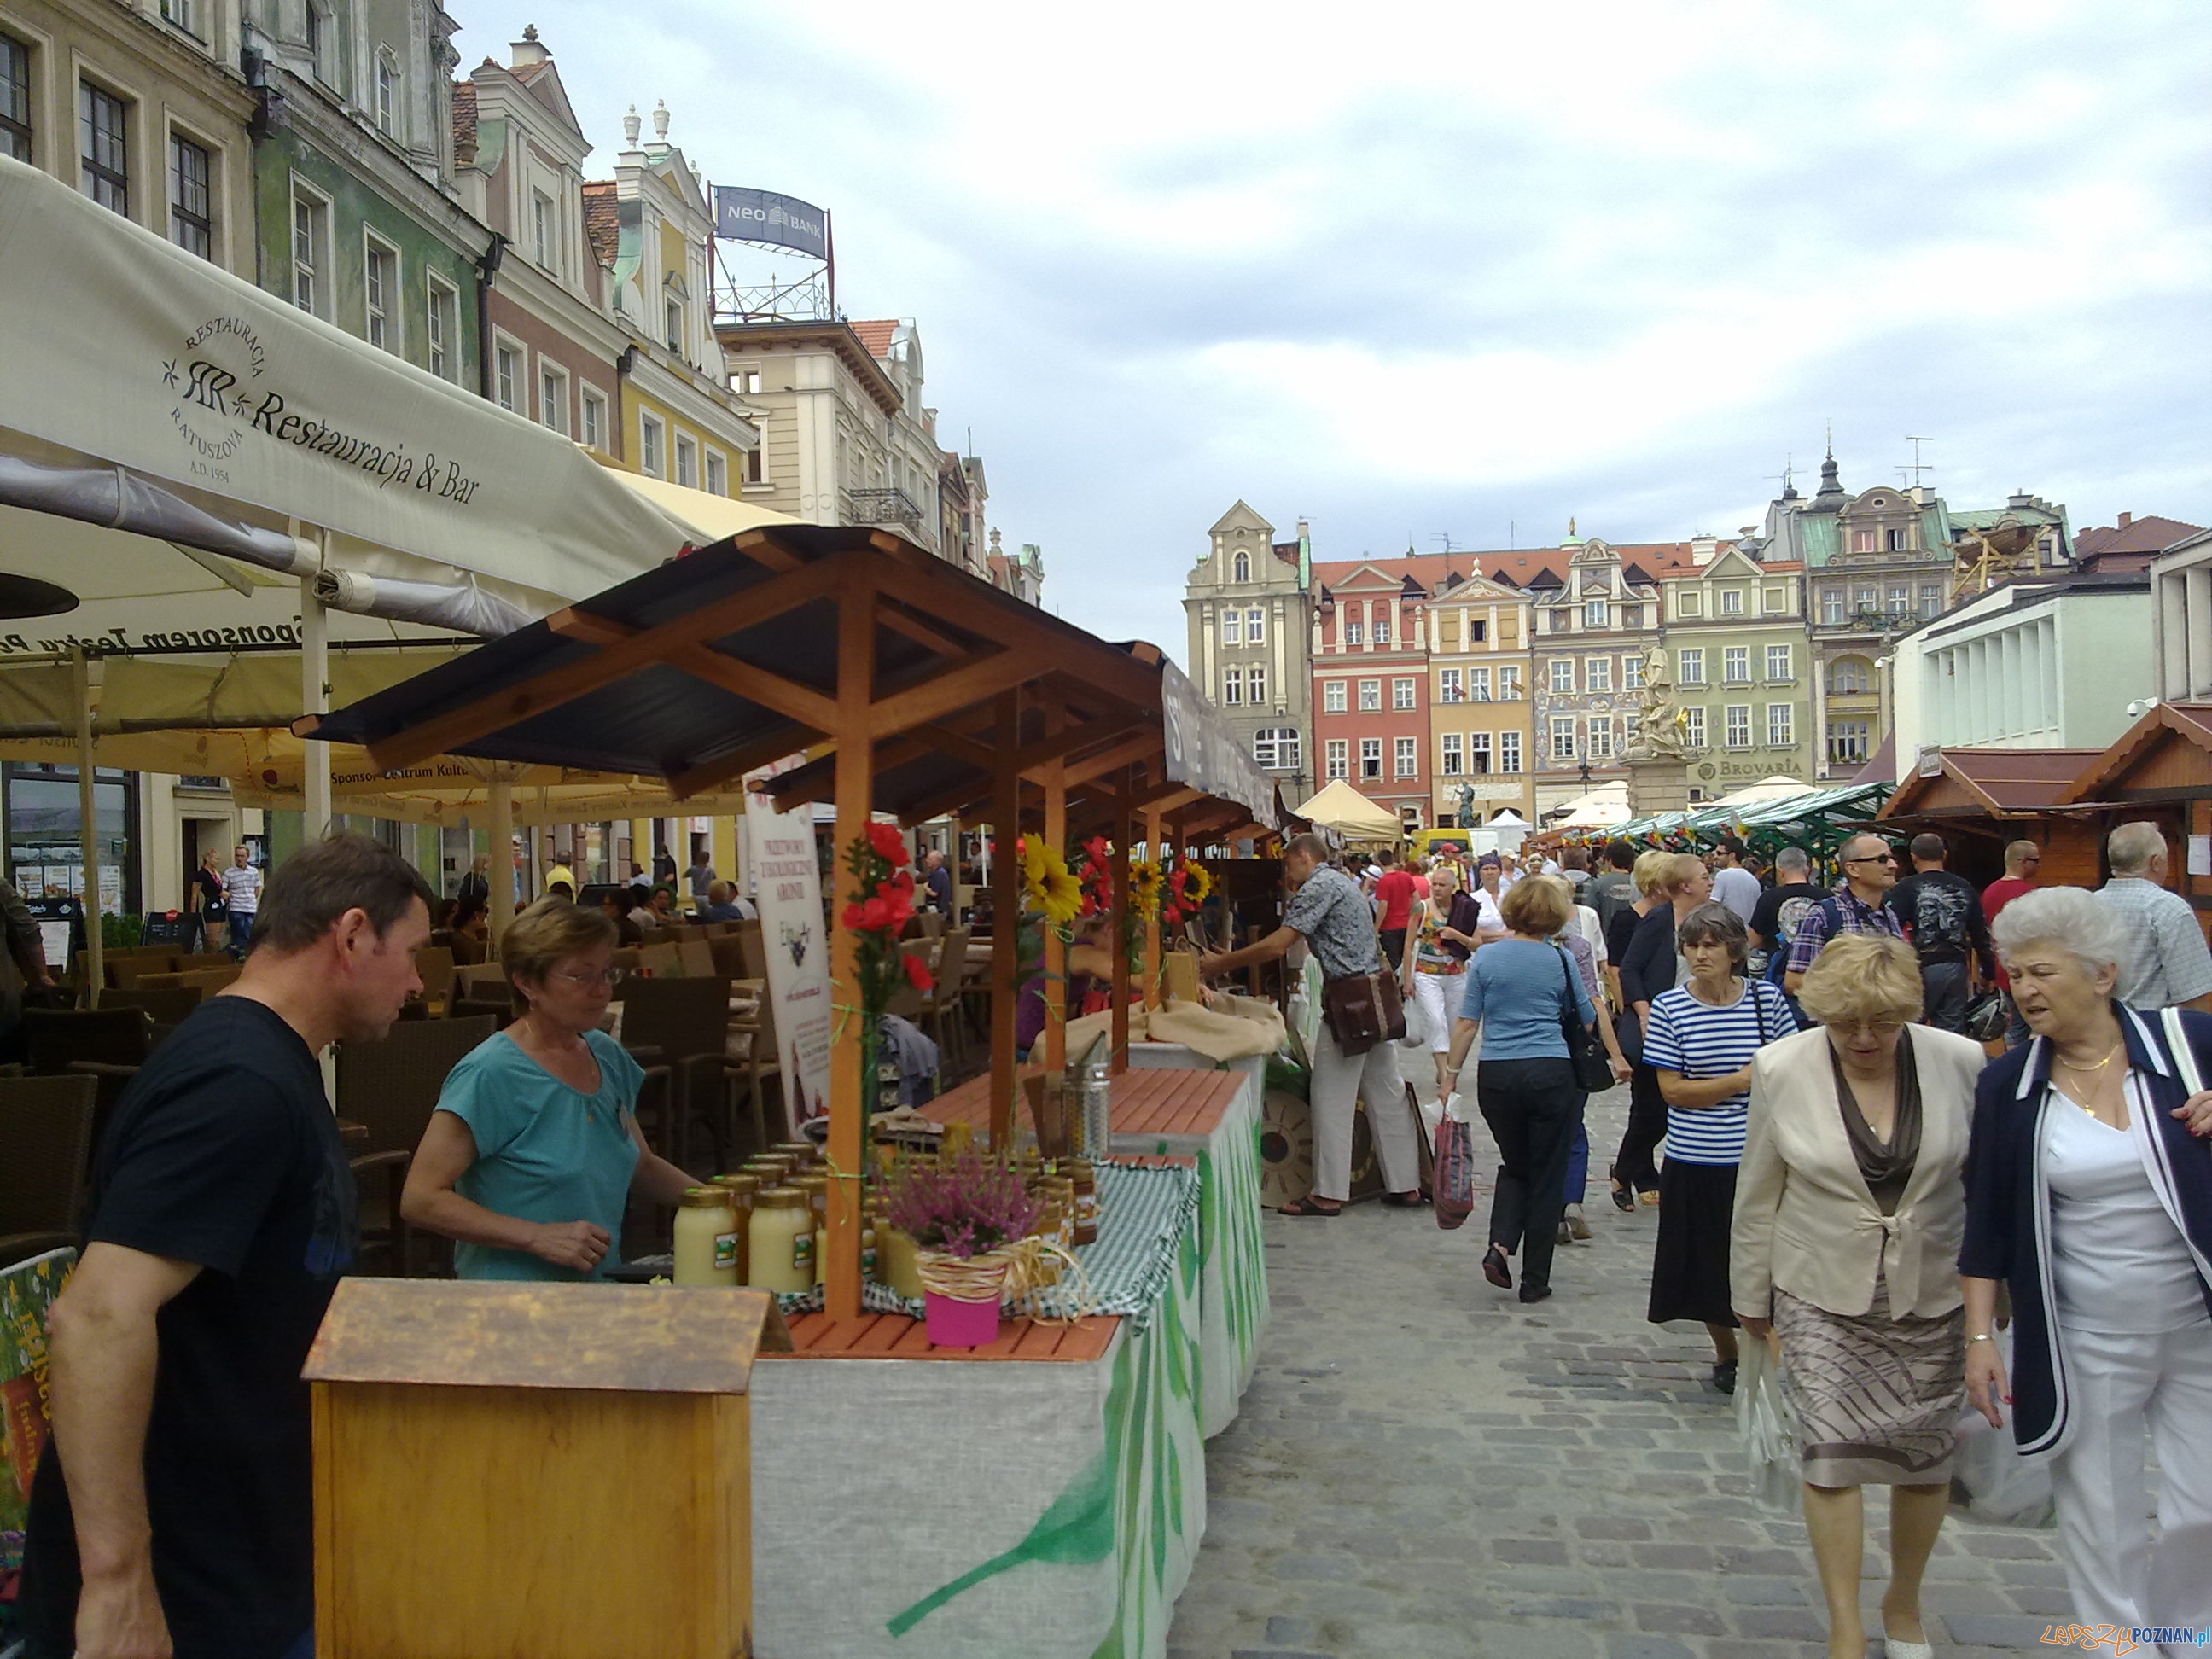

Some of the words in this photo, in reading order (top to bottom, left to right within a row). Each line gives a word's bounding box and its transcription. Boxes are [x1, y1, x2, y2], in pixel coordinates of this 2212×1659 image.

[789, 215, 822, 239] BANK
[185, 317, 265, 379] RESTAURACJA
[171, 406, 243, 460] RATUSZOVA
[249, 391, 414, 490] Restauracja
[416, 453, 439, 492] &
[438, 460, 480, 505] Bar
[211, 466, 230, 484] 1954
[1720, 758, 1802, 776] BROVARIA
